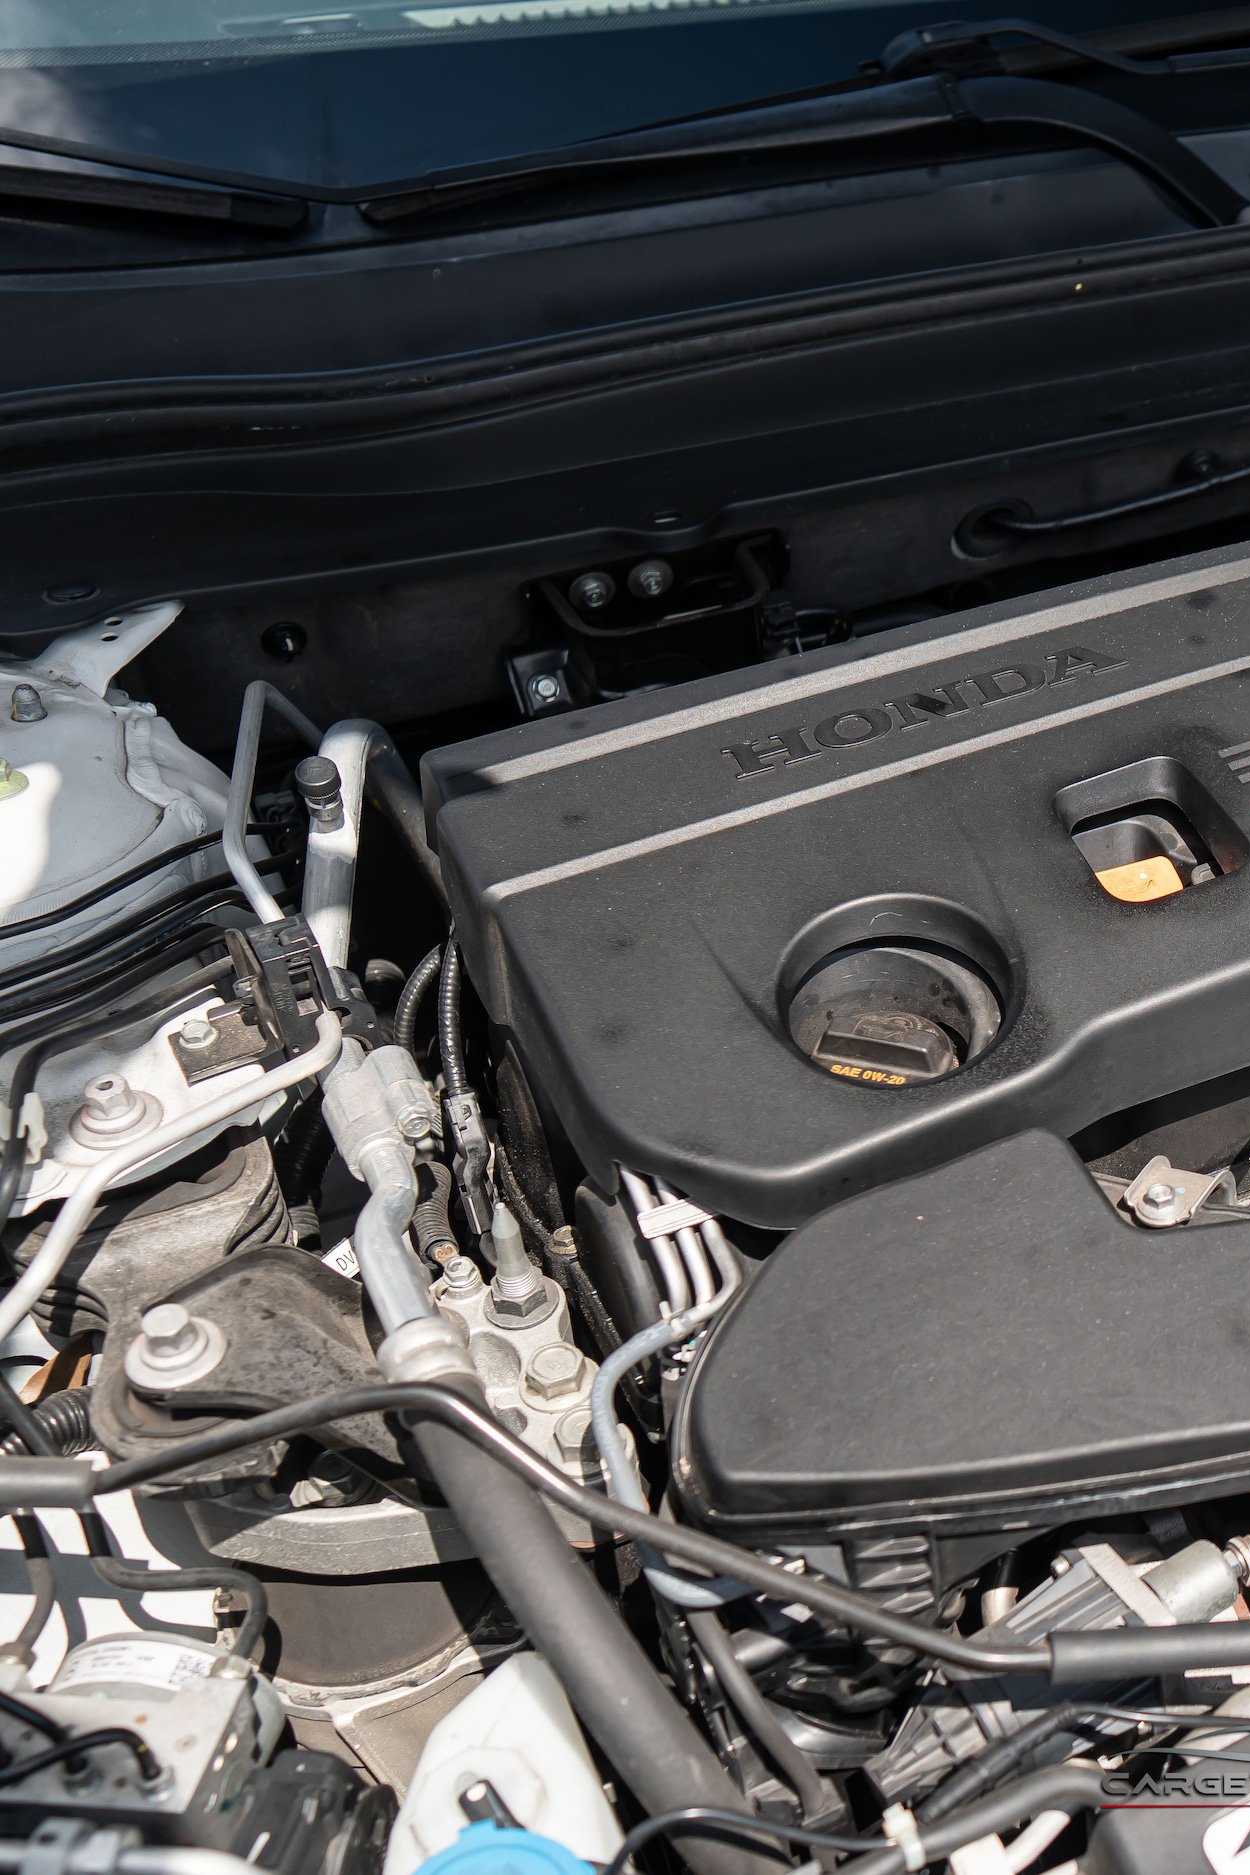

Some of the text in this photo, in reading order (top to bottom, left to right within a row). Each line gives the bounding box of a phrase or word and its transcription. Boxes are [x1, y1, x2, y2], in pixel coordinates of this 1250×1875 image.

[721, 646, 1129, 780] HONDA
[831, 1064, 906, 1085] SAE 0W-20
